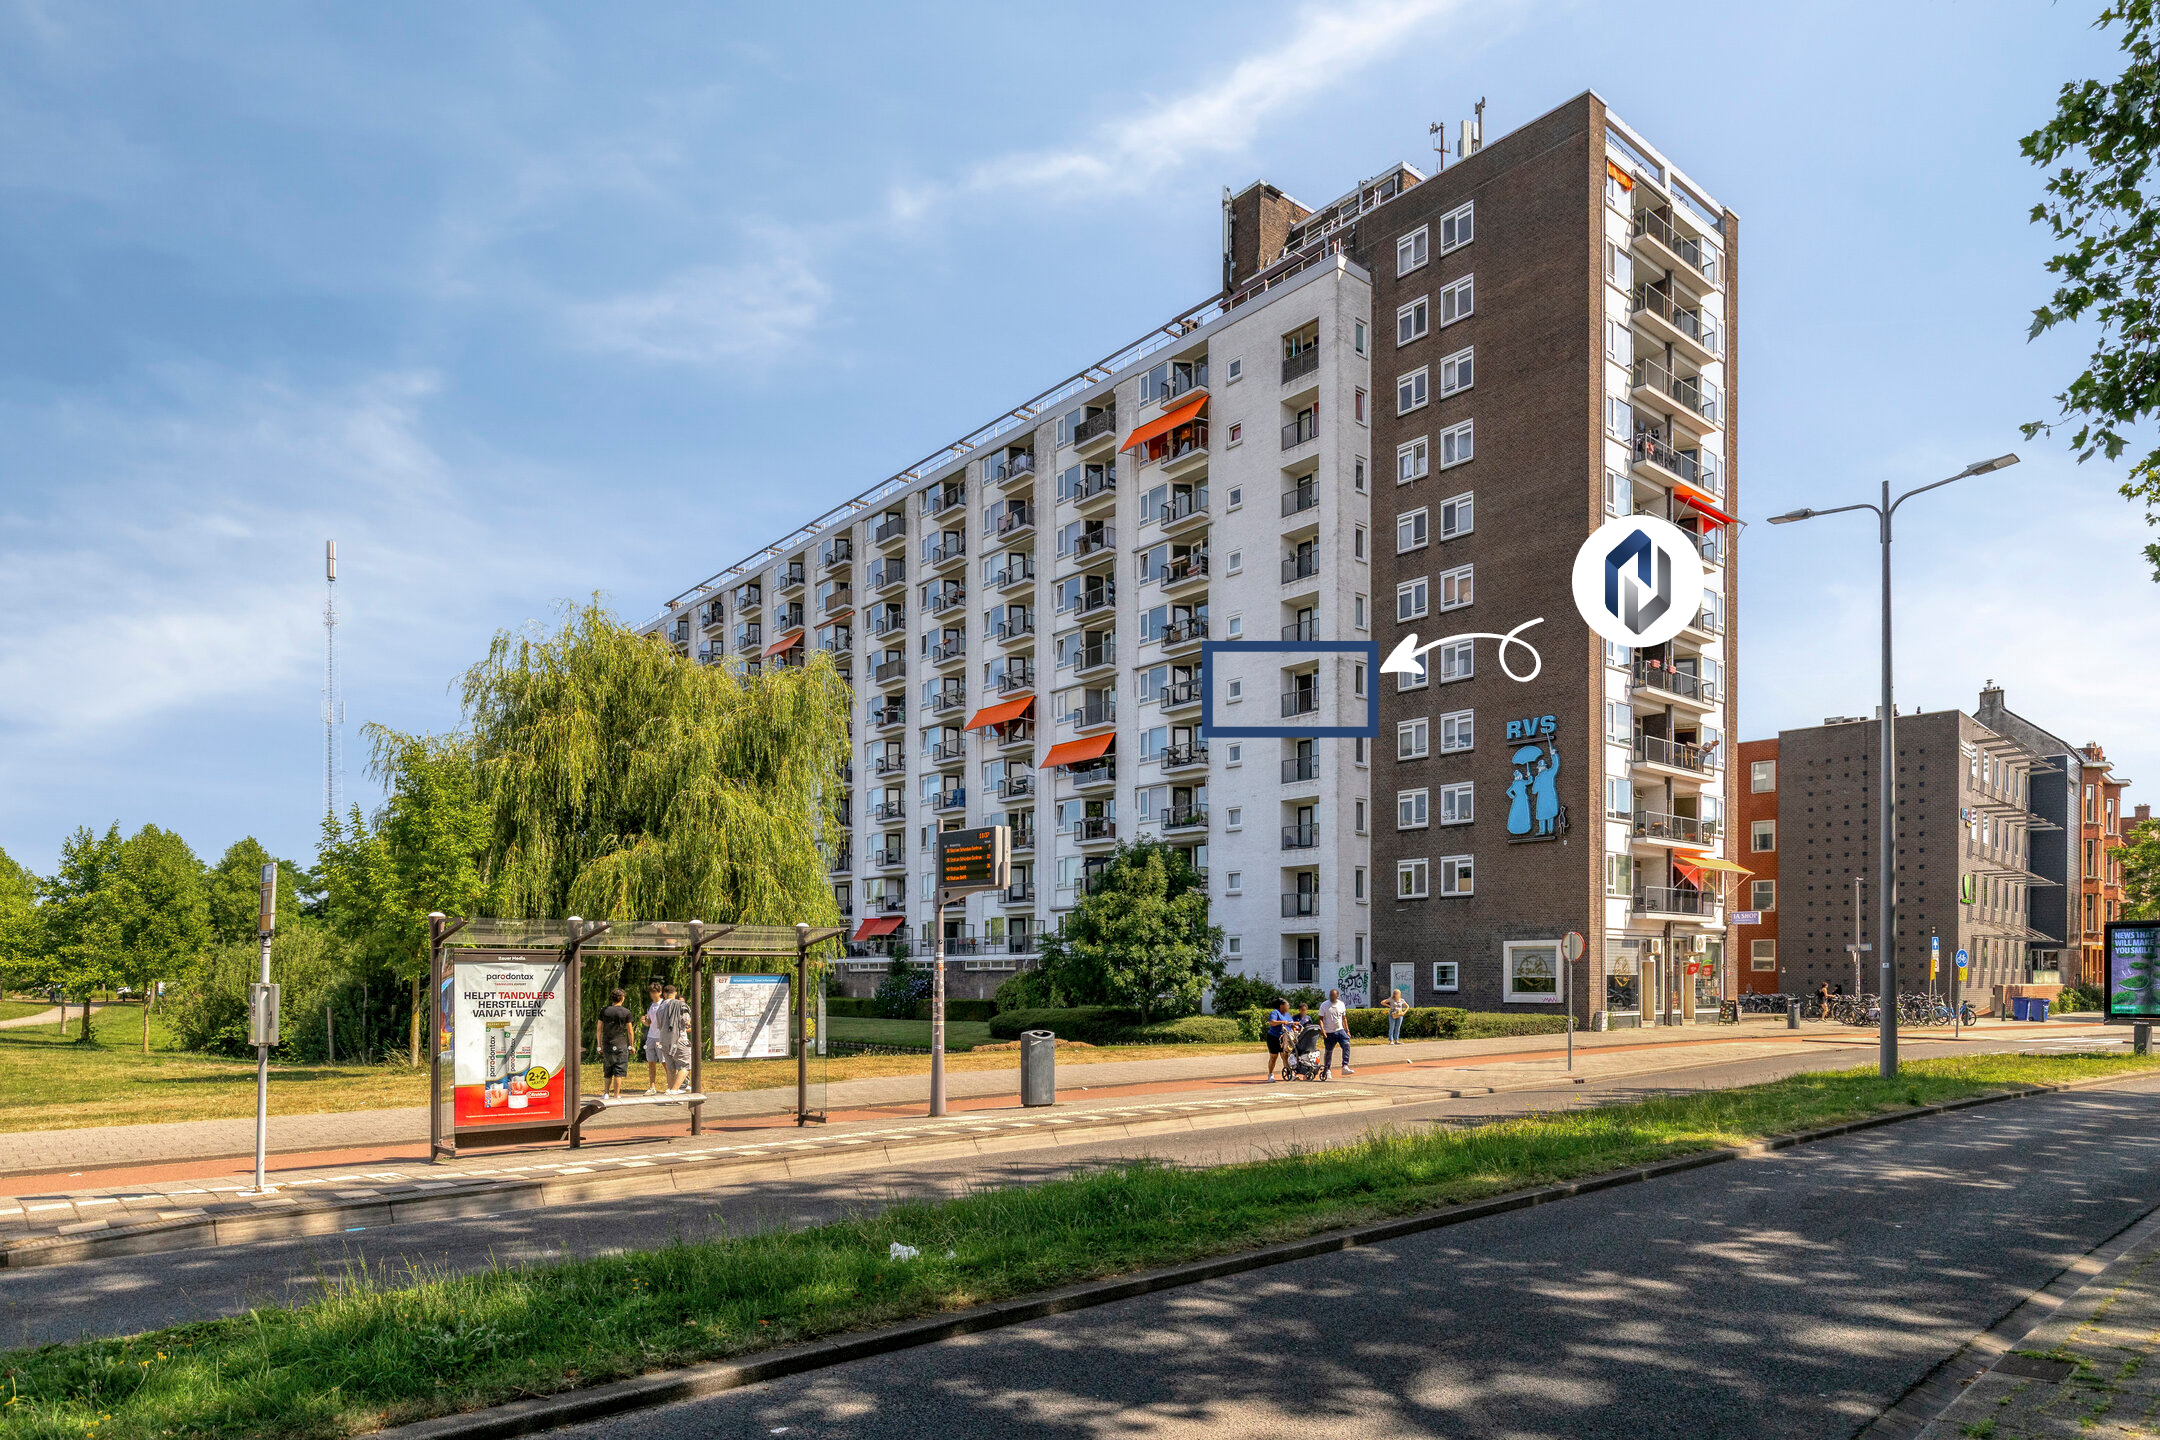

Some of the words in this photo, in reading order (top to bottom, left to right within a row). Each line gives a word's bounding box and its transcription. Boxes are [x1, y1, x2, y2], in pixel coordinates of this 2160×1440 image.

[1506, 715, 1557, 739] RVS
[2136, 931, 2155, 939] THAT
[2131, 946, 2153, 954] SMILE
[486, 972, 534, 981] parodontax
[464, 991, 497, 1000] HELPT
[498, 991, 555, 1000] TANDVLEES
[478, 1000, 541, 1009] HERSTELLEN
[472, 1009, 506, 1018] VANAF
[528, 1070, 547, 1082] 2+2
